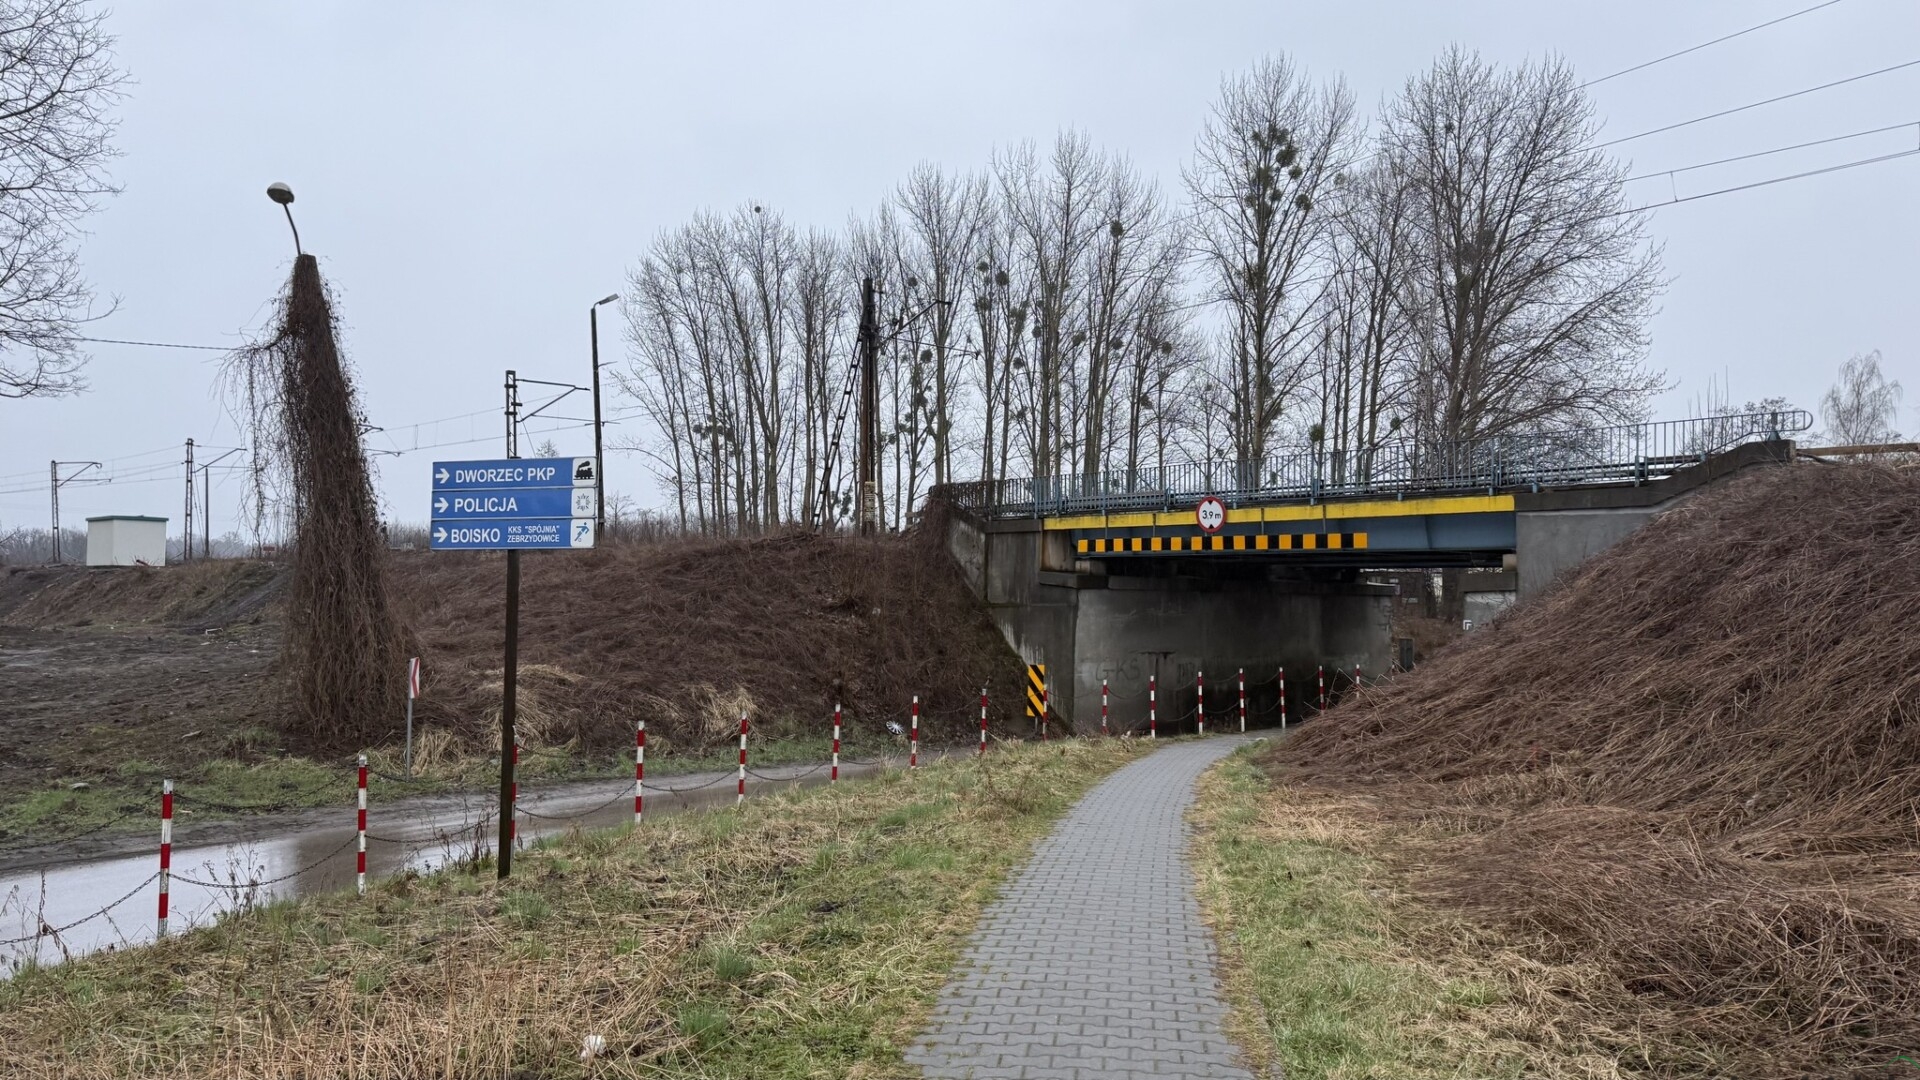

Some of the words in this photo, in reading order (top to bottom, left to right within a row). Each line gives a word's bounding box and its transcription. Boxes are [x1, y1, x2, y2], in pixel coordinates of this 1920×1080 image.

[455, 469, 523, 483] DWORZEC
[527, 467, 555, 481] PKP
[454, 497, 518, 512] POLICJA
[451, 528, 501, 543] BOISKO
[507, 525, 522, 534] KKS
[525, 524, 560, 534] "SPÓJNIA"
[507, 534, 560, 543] ZEBRZYDOWICE
